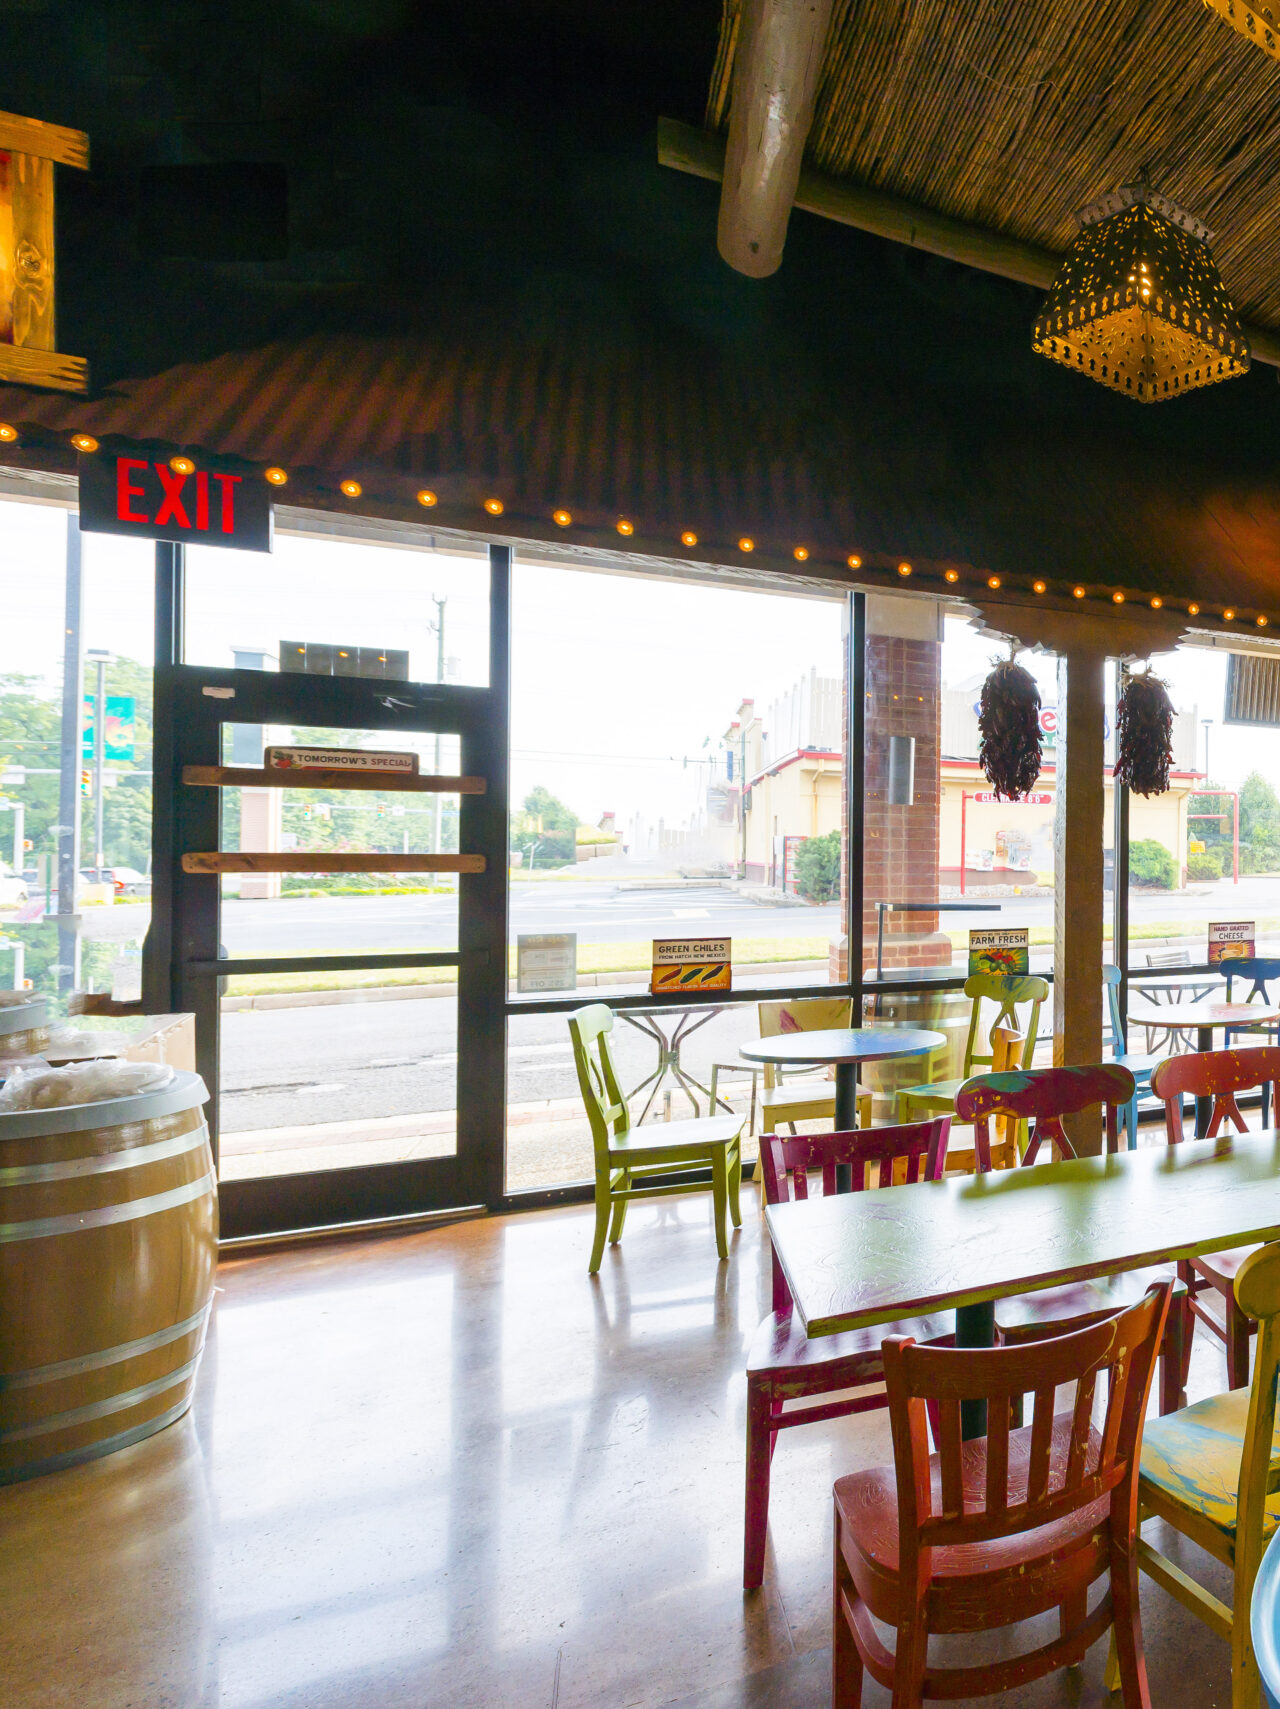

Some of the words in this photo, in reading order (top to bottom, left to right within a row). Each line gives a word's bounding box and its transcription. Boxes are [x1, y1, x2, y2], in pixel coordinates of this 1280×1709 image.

[117, 457, 243, 534] EXIT
[297, 754, 368, 765] TOMORROW'S
[971, 936, 995, 945] FARM
[998, 935, 1026, 944] FRESH
[1218, 932, 1244, 940] CHEESE
[658, 945, 690, 953] GREEN
[693, 943, 725, 952] CHILES
